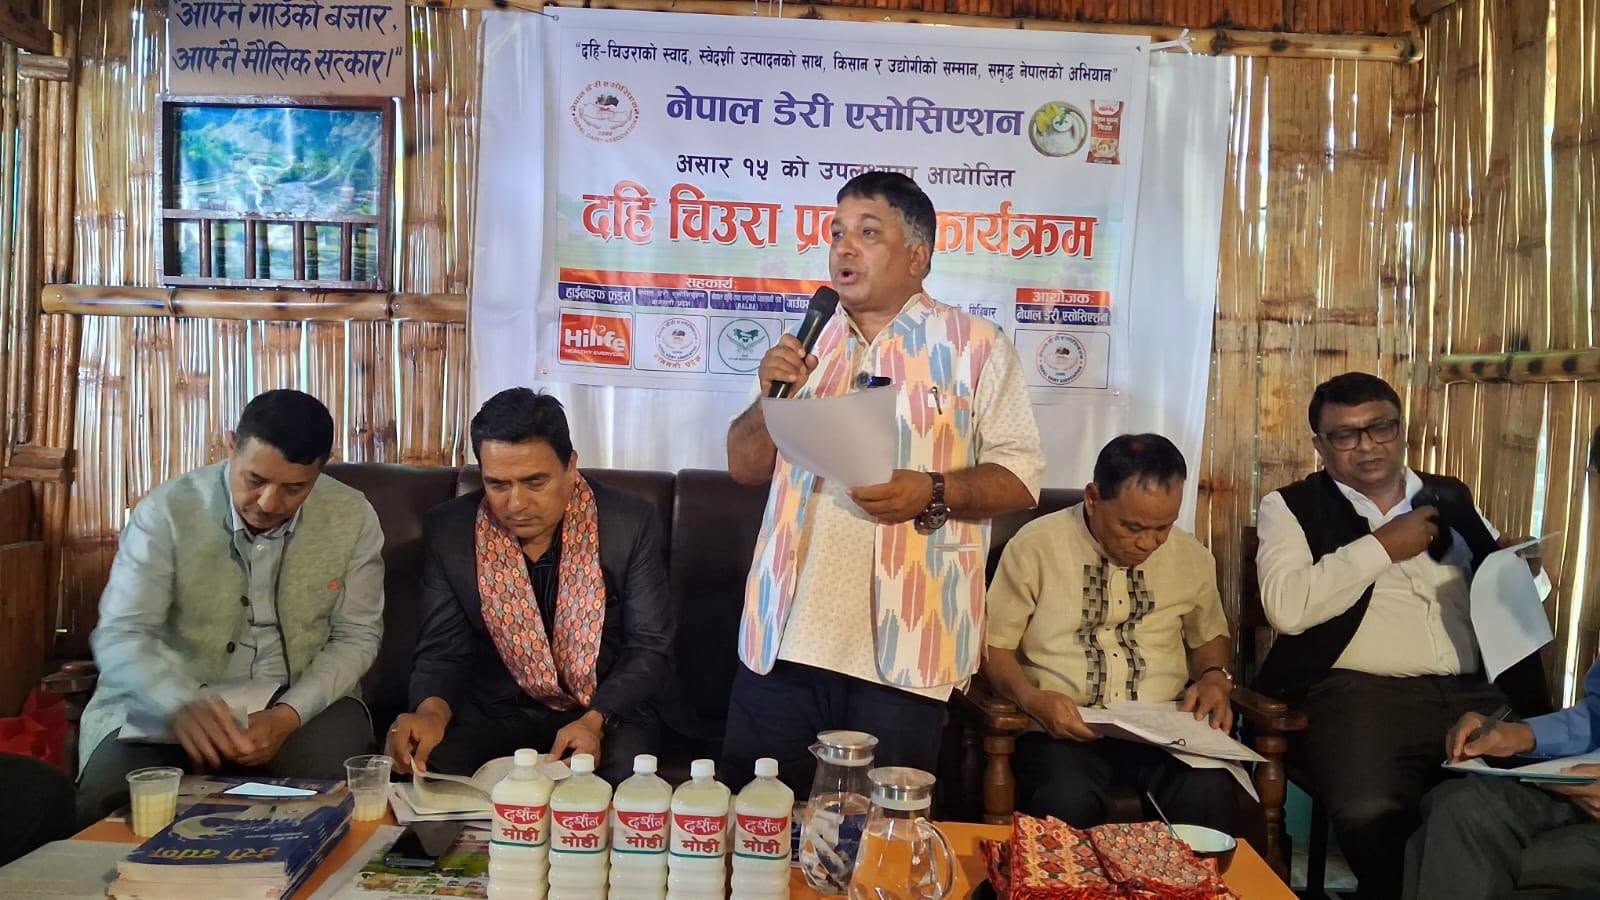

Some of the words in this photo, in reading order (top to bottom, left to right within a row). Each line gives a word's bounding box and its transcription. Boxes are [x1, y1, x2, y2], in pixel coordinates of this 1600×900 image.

[325, 3, 397, 34] बजार,
[172, 38, 242, 76] आफ्नै
[242, 39, 311, 80] मौलिक
[663, 47, 692, 65] स्वाद,
[740, 50, 797, 69] उत्पादनको
[802, 54, 826, 73] साथ,
[833, 50, 869, 72] किसान
[874, 57, 882, 74] र
[888, 55, 938, 74] उद्योगीको
[943, 61, 981, 79] सम्मान,
[988, 63, 1015, 83] समृद्ध
[1019, 60, 1063, 80] नेपालको
[666, 85, 763, 124] नेपाल
[774, 90, 834, 129] डेरी
[844, 95, 1025, 136] एसोसिएशन
[676, 153, 733, 178] असार
[743, 157, 769, 181] १५
[781, 155, 809, 179] को
[928, 161, 1016, 187] आयोजित
[581, 180, 657, 245] दहि
[668, 182, 783, 248] चिउरा
[933, 200, 1099, 259] कार्यक्रम
[1016, 307, 1041, 320] नेपाल
[1043, 308, 1060, 322] डेरी
[1062, 309, 1109, 324] एसोसिएशन
[503, 806, 541, 823] दर्शन
[561, 813, 599, 830] दर्शन
[627, 813, 664, 830] दर्शन
[683, 818, 721, 833] दर्शन
[744, 818, 782, 833] दर्शन
